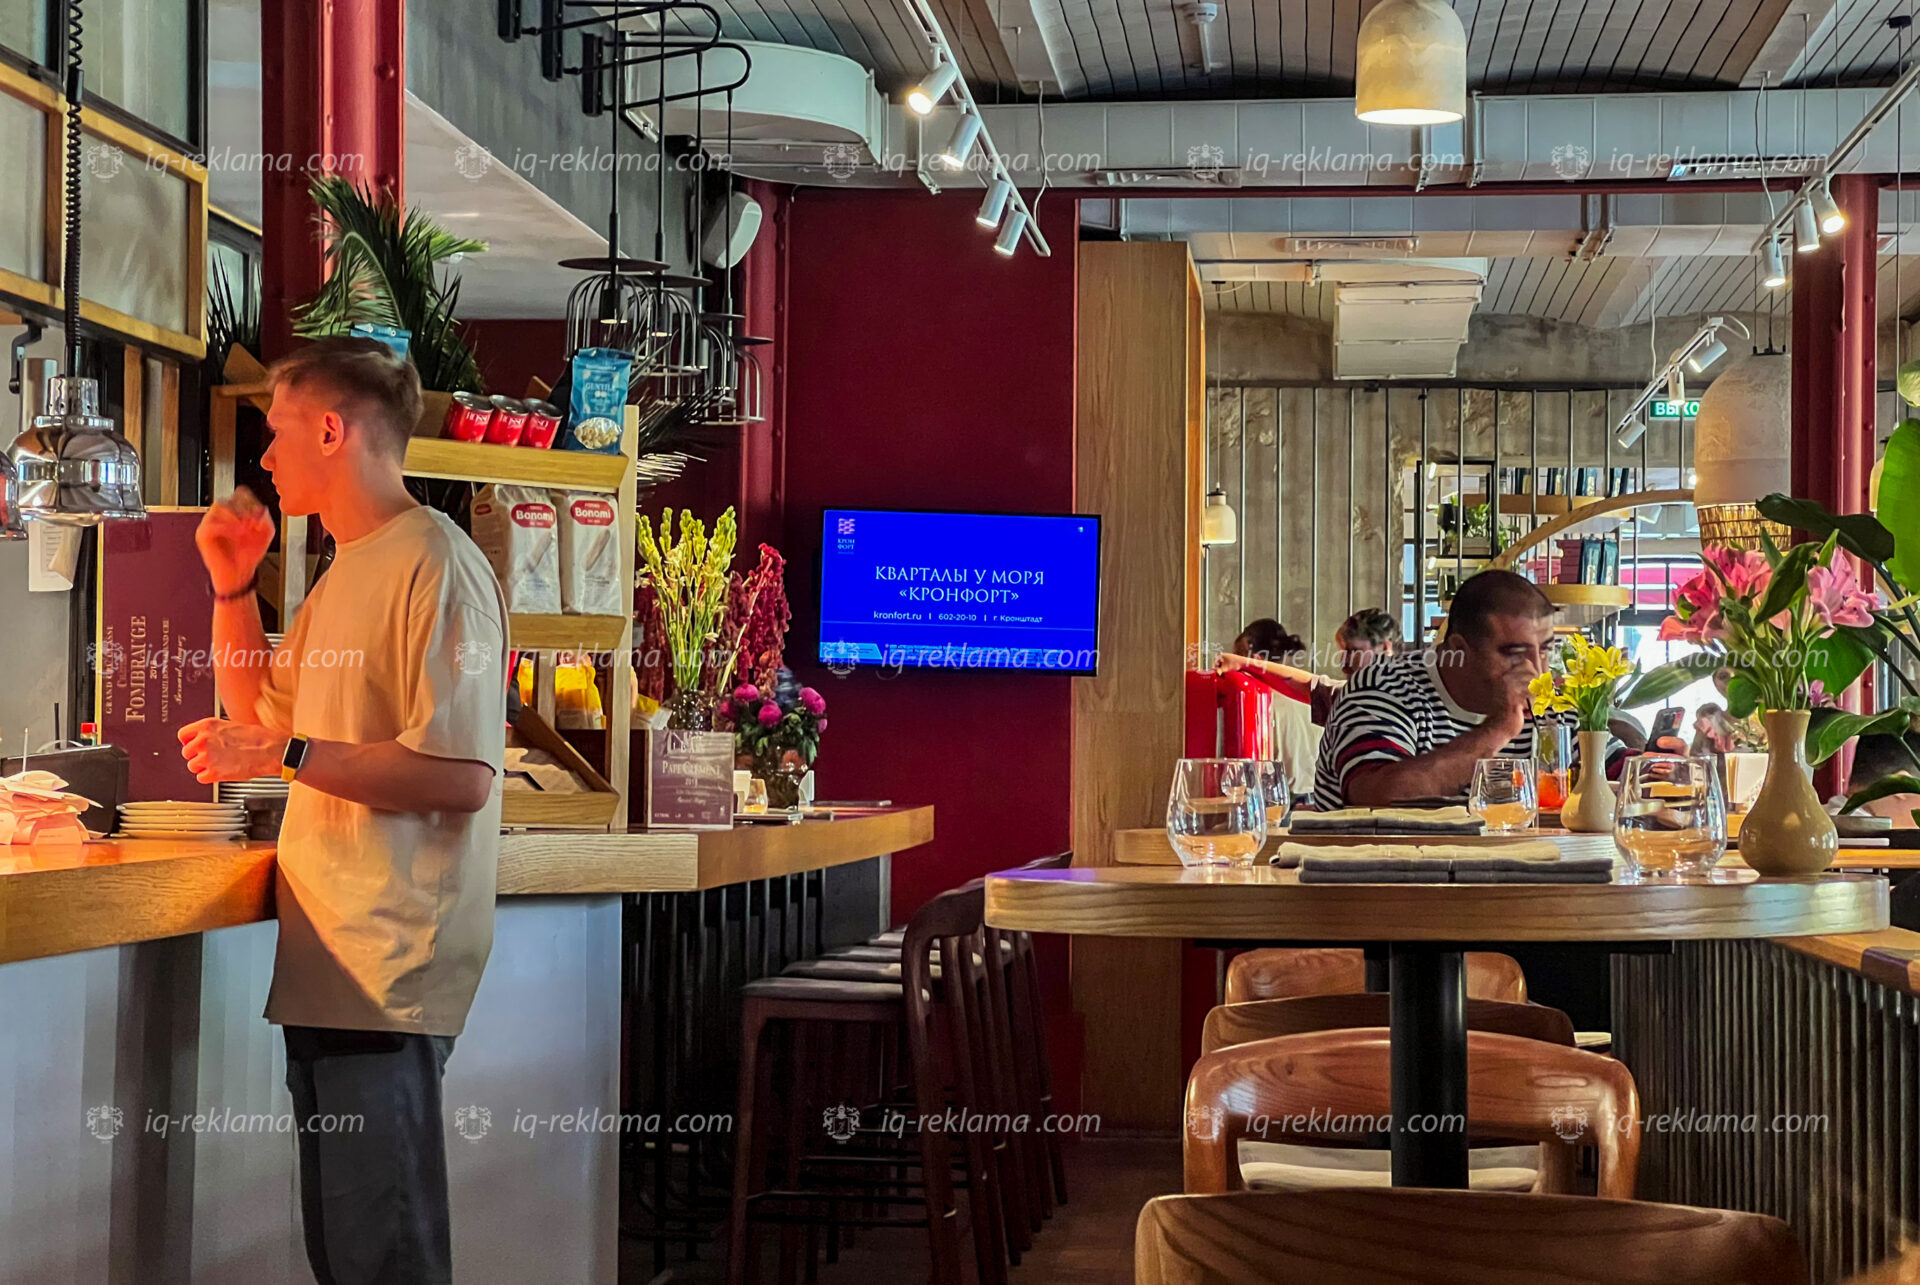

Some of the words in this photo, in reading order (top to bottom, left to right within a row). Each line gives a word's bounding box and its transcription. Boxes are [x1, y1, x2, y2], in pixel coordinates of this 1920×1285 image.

[875, 565, 968, 583] КВАРТАЛЫ
[974, 569, 986, 585] У
[991, 570, 1044, 585] МОРЯ
[899, 586, 1019, 603] «КРОНФОРТ»
[873, 610, 922, 620] kronfort.ru
[938, 613, 977, 621] 602-20-10
[1000, 615, 1043, 623] Кронштадт
